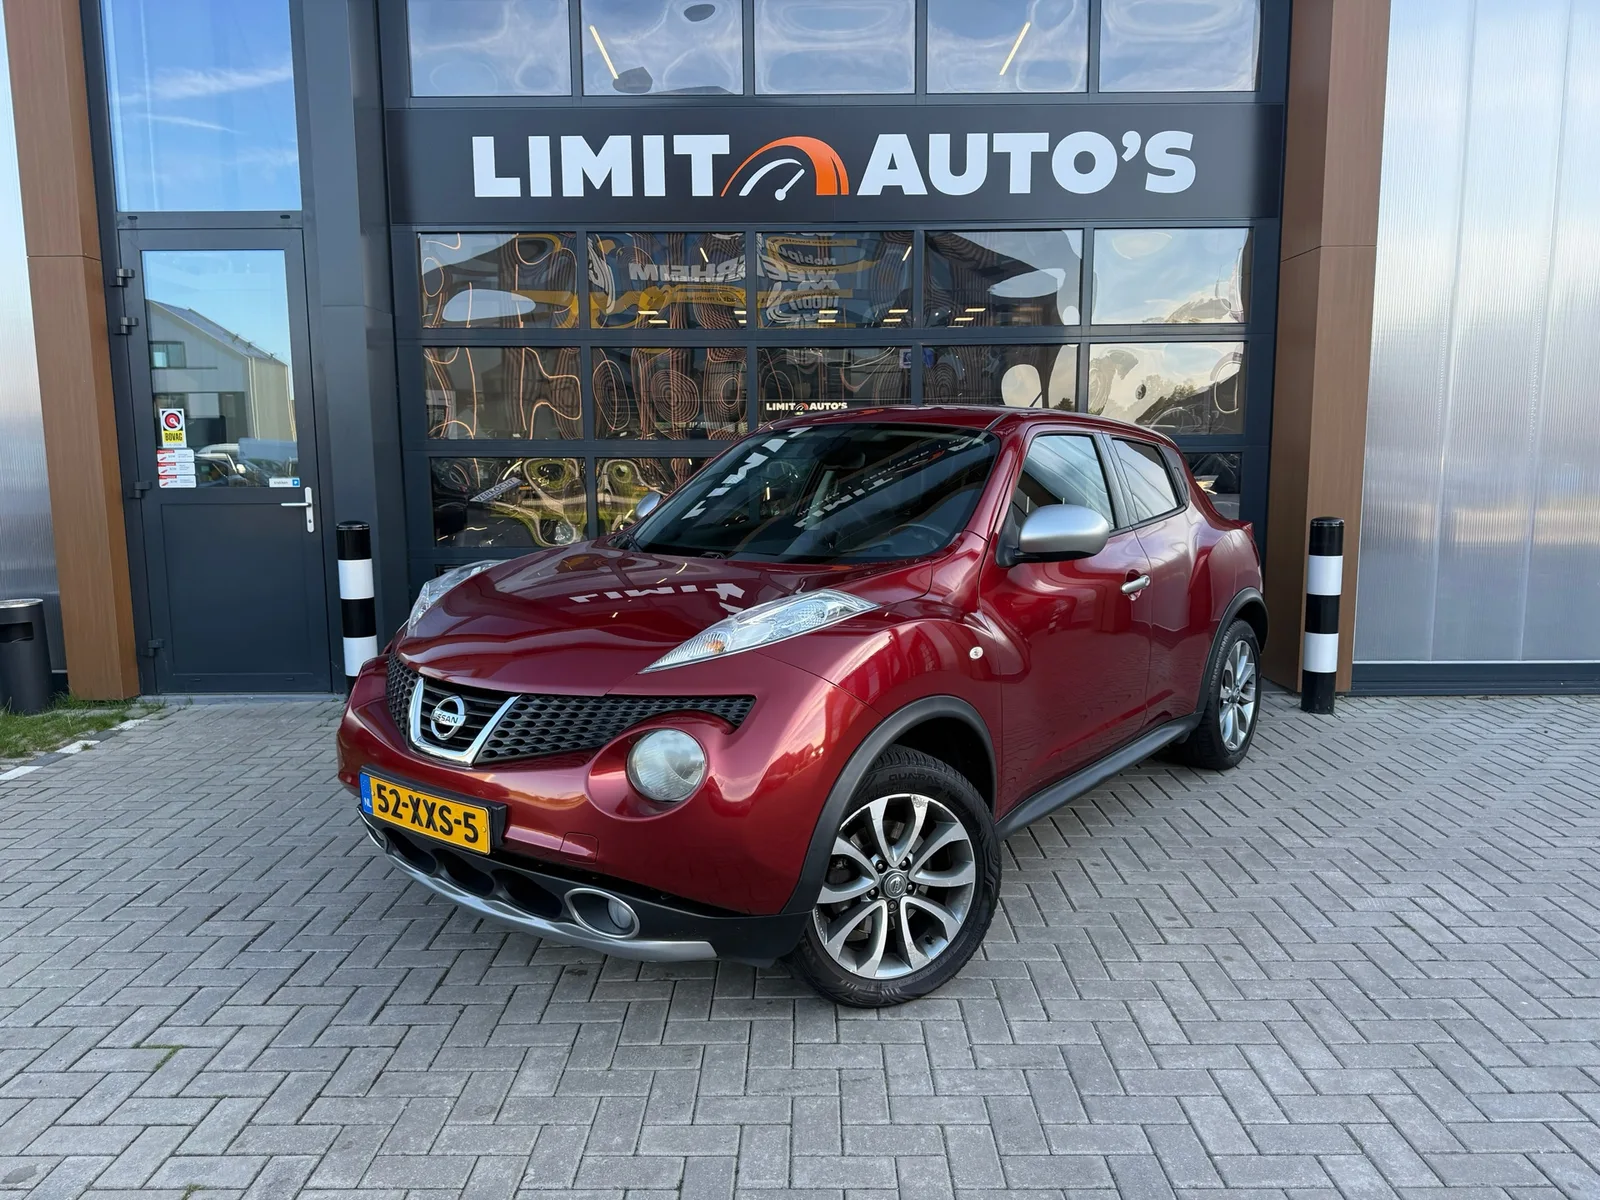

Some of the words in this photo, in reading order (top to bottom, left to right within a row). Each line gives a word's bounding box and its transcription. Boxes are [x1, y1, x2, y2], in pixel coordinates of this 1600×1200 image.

[472, 134, 729, 197] LIMIT
[856, 130, 1196, 196] AUTO'S
[766, 402, 796, 411] LIMIT
[809, 402, 848, 411] AUTO'S
[164, 432, 183, 442] BOVAG
[364, 797, 373, 808] NL
[376, 783, 479, 843] 52-XXS-5
